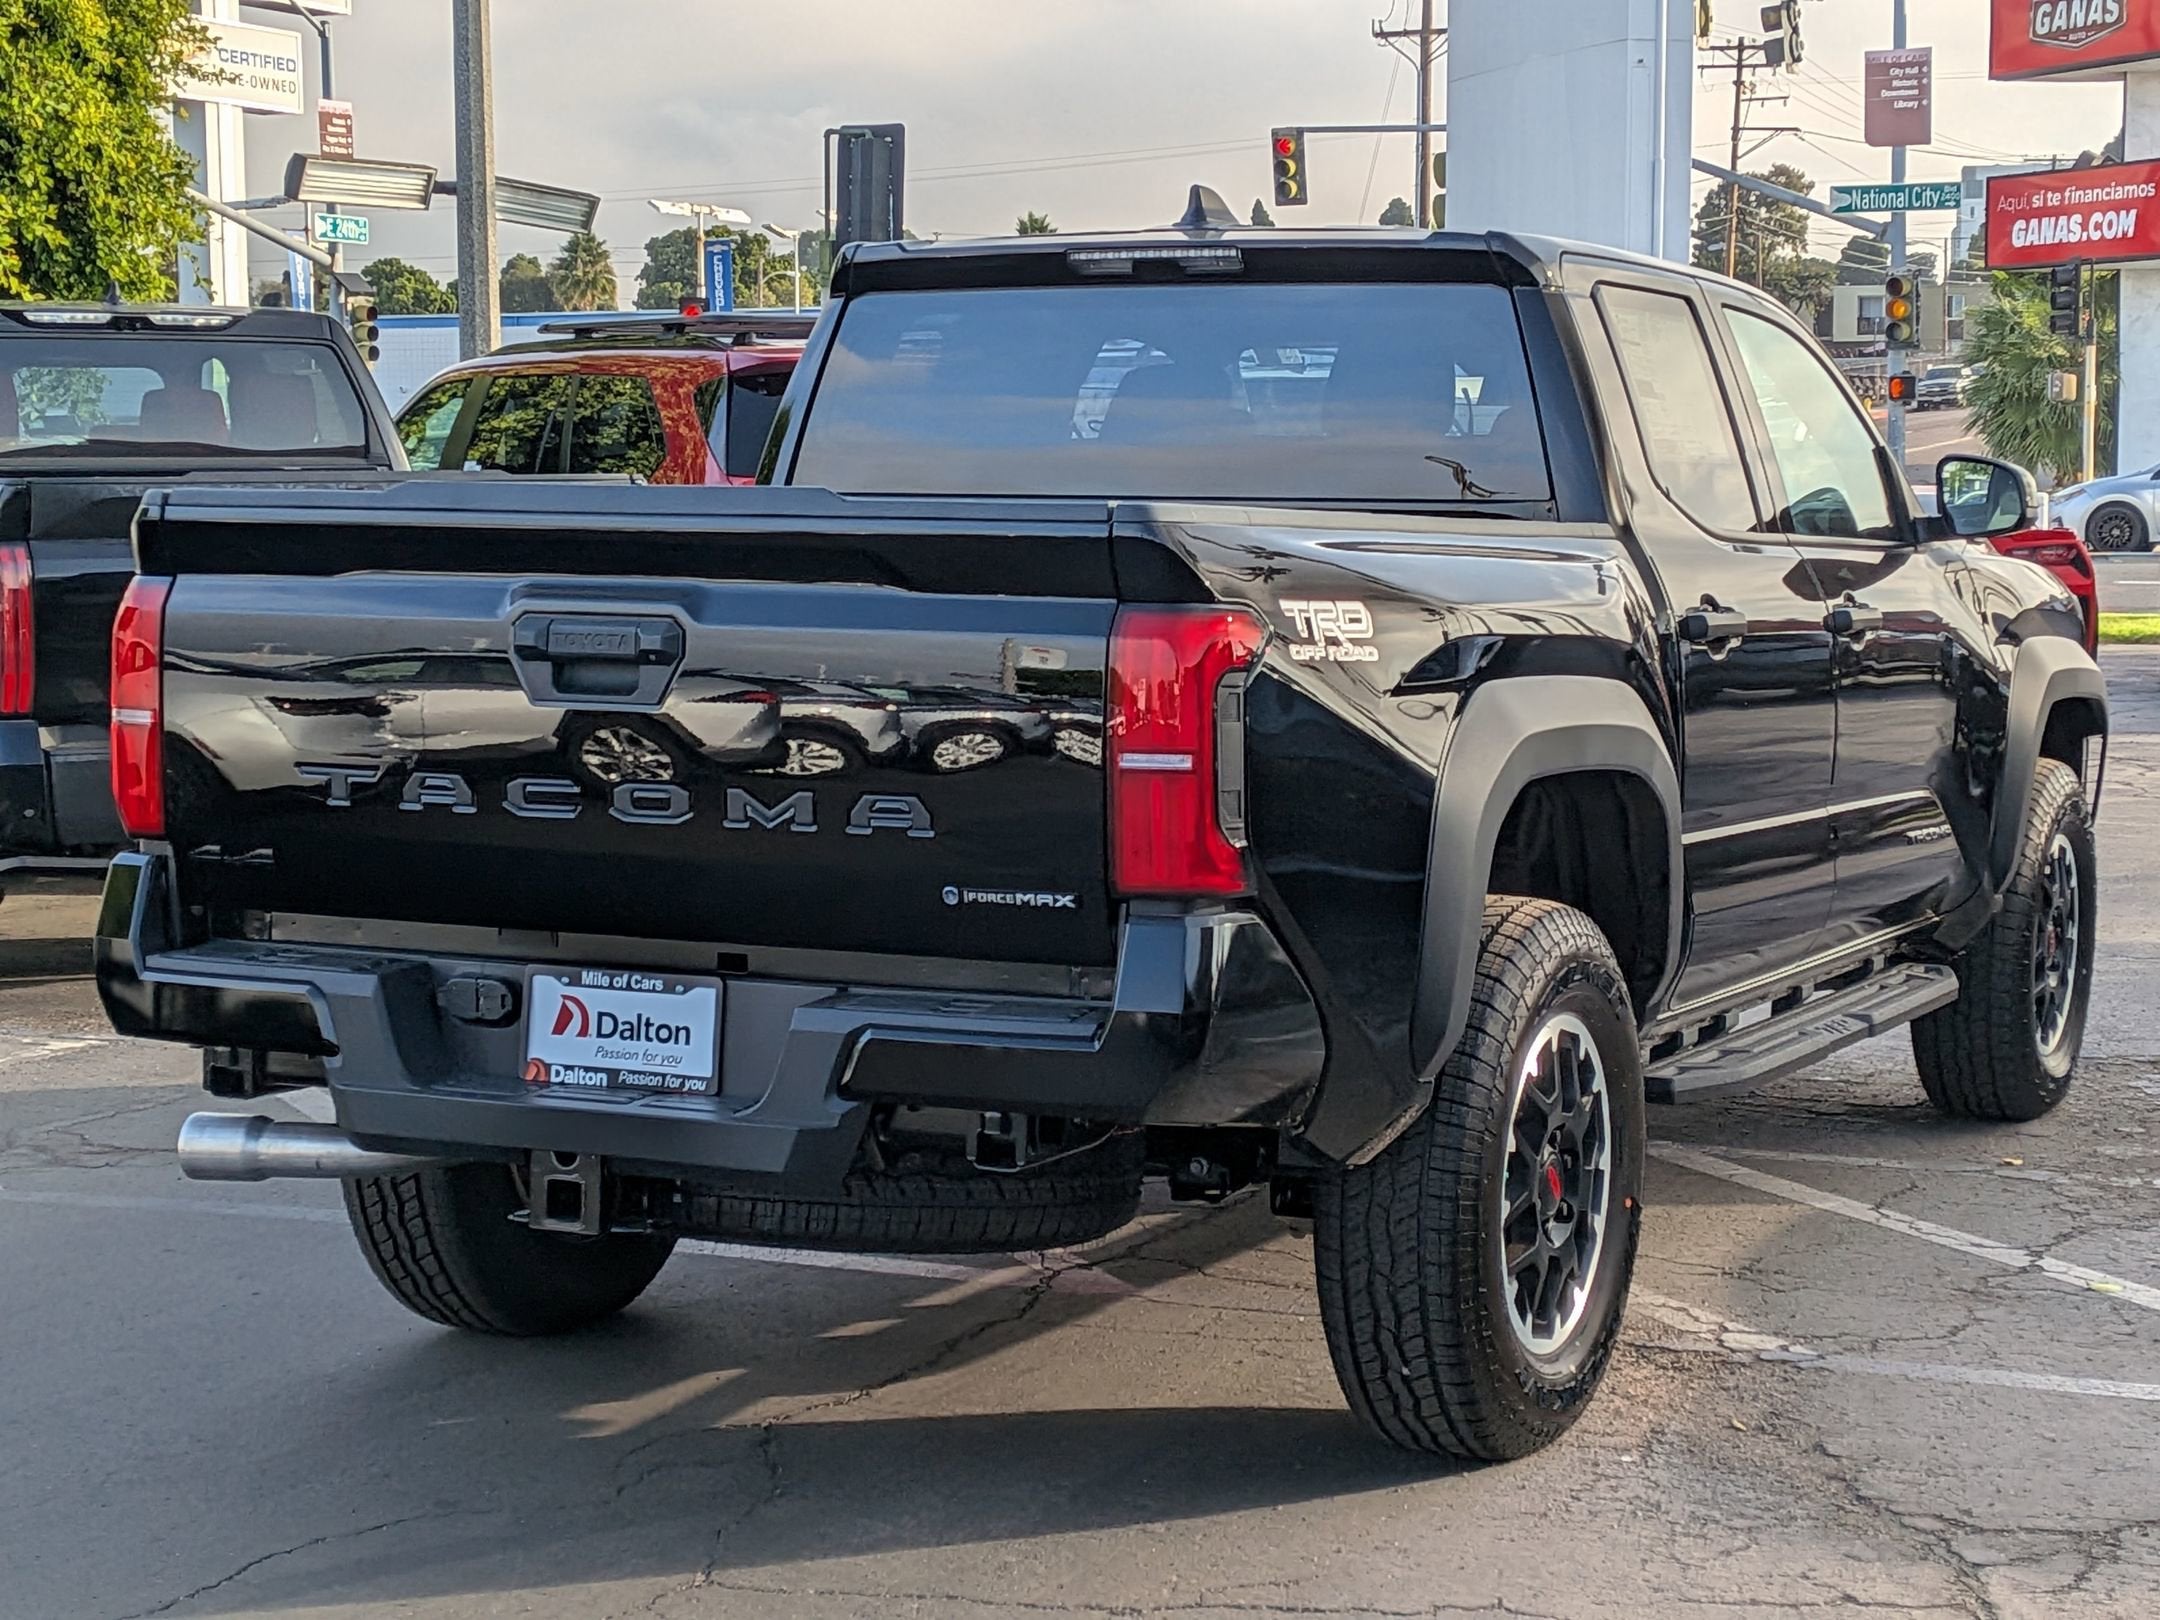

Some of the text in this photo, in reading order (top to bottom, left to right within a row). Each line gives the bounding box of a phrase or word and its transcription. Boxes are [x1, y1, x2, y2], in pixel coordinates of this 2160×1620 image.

[2035, 0, 2120, 35] GANAS
[218, 48, 297, 73] CERTIFIED
[1889, 67, 1904, 77] City
[1894, 100, 1919, 109] Library
[1851, 187, 1909, 210] National
[1911, 186, 1941, 208] City
[2047, 189, 2061, 207] te
[2064, 181, 2156, 205] financiamos
[326, 218, 336, 238] E
[2011, 209, 2138, 248] GANAS.COM
[1279, 600, 1374, 648] TRD
[552, 632, 629, 649] TOYOTA
[294, 763, 936, 838] TACOMA
[581, 970, 664, 991] Mile of Cars
[596, 1011, 692, 1046] Dalton
[594, 1045, 684, 1068] Passion for you
[551, 1065, 708, 1092] Dalton Passion for you
